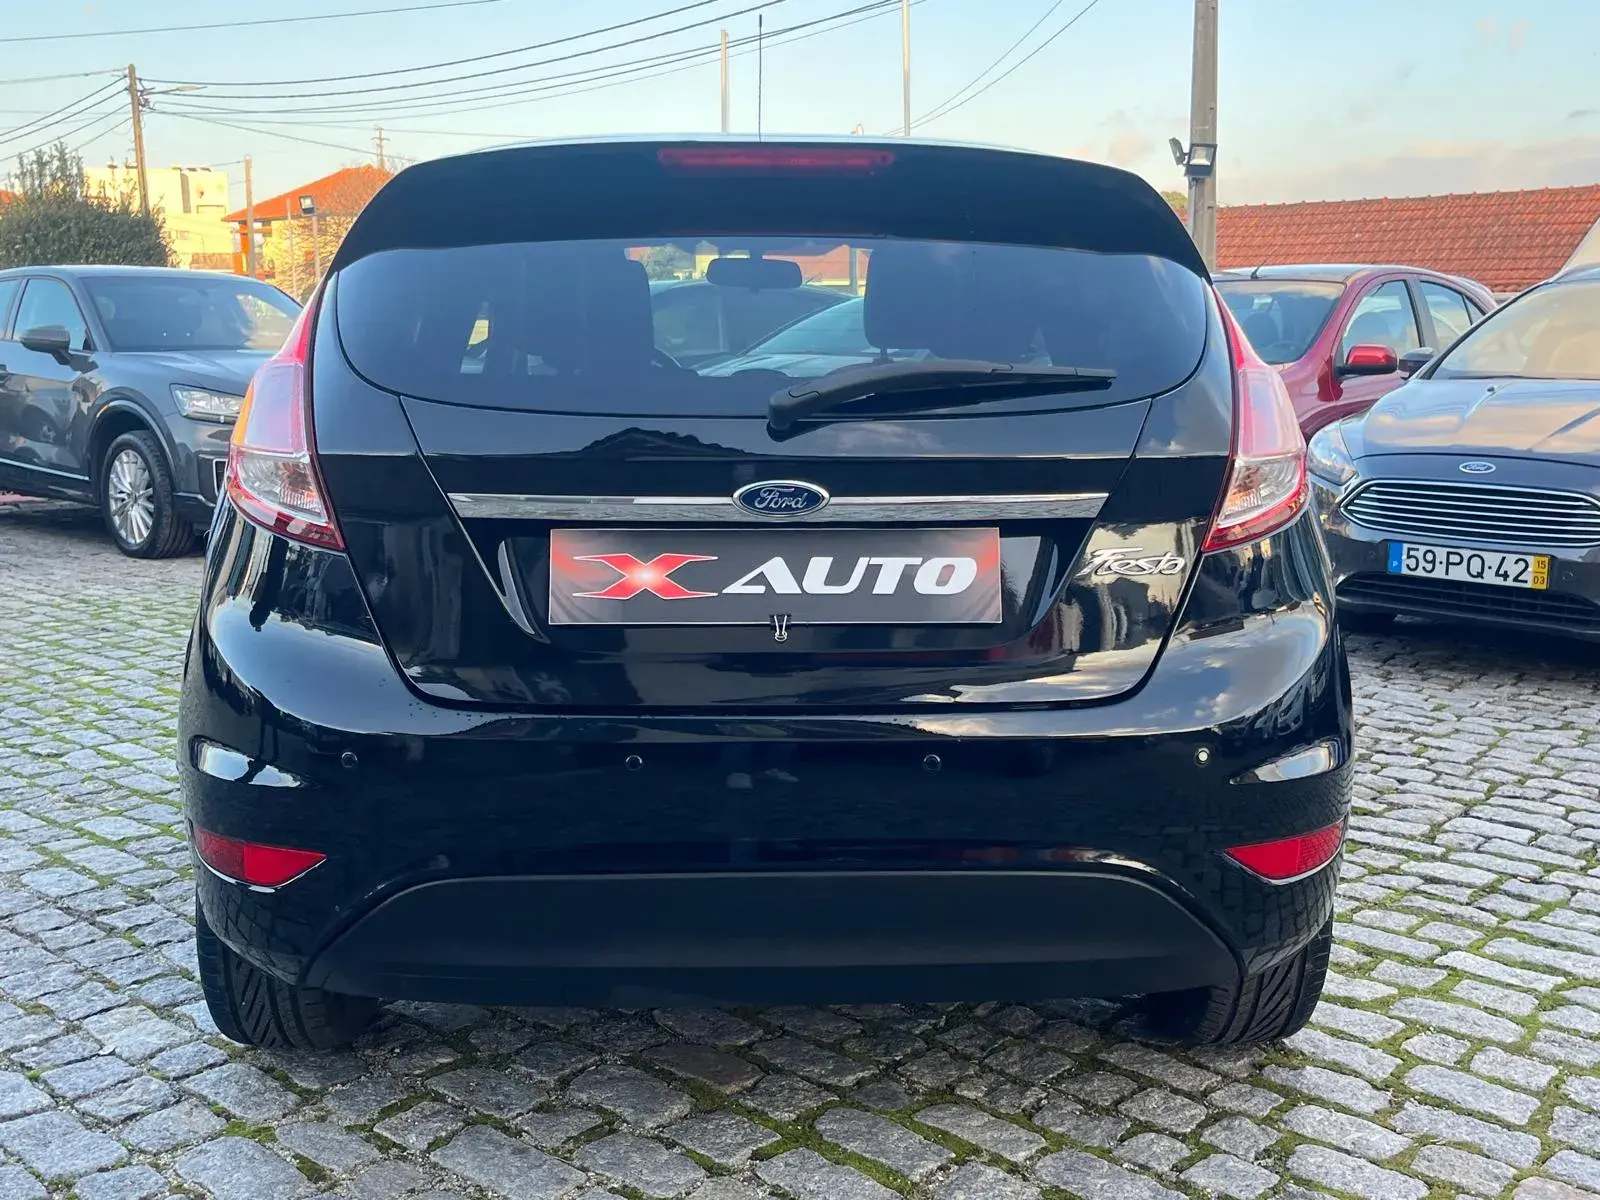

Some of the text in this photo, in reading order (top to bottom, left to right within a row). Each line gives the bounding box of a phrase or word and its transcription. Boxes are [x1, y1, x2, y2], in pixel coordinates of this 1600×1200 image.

[754, 487, 809, 508] Ford
[1075, 547, 1186, 576] Fiesta
[1536, 559, 1546, 570] 15
[721, 556, 978, 595] AUTO
[1533, 576, 1545, 585] 03
